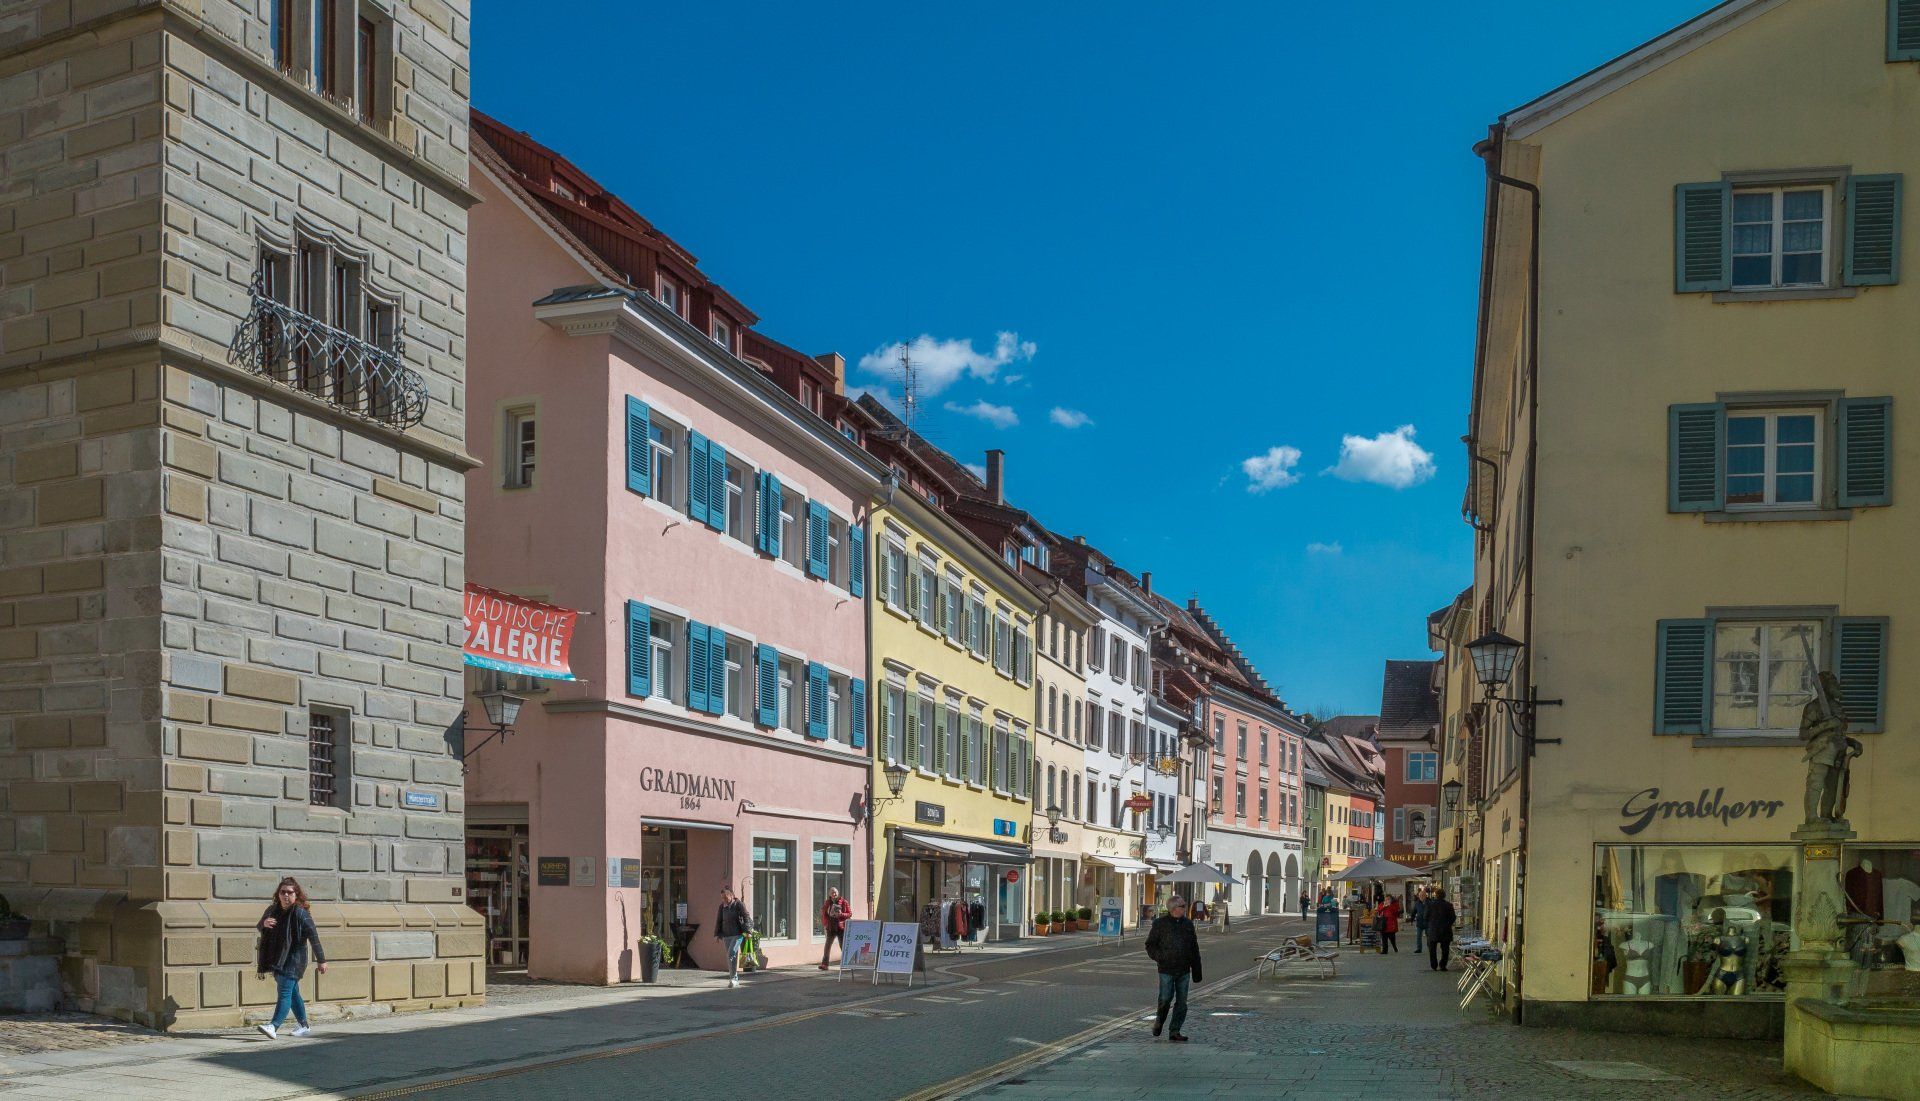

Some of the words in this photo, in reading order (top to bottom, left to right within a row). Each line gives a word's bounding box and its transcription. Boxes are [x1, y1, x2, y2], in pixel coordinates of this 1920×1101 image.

[468, 590, 568, 638] TÄDTISCHE
[640, 766, 736, 802] GRADMANN
[680, 797, 701, 811] 1864
[1619, 787, 1784, 835] Grabherr
[886, 933, 913, 945] 20%
[883, 949, 911, 959] DÜFTE
